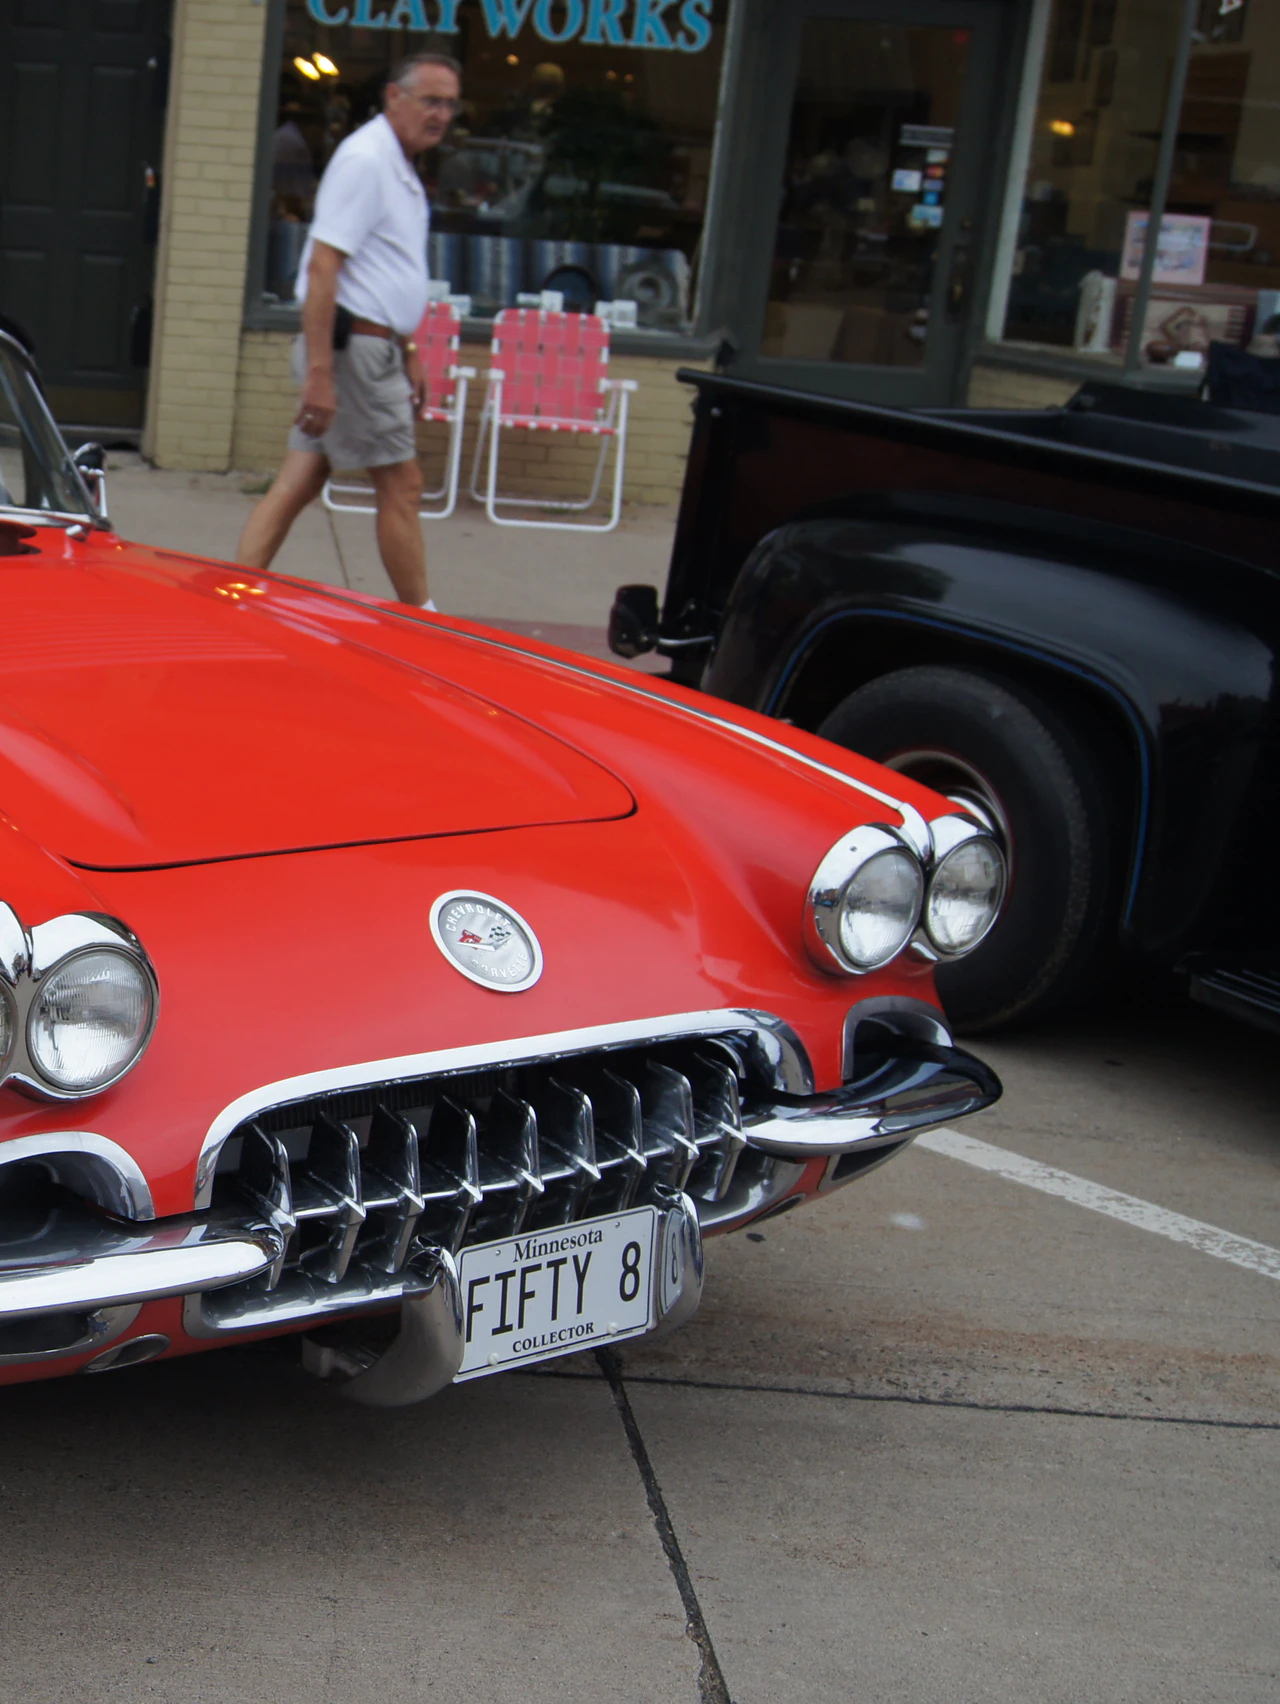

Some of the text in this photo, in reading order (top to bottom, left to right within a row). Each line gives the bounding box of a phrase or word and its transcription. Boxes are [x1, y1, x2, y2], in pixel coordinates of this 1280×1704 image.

[481, 0, 712, 52] WORKS
[445, 903, 511, 932] CHEVROLET
[470, 952, 528, 978] CORVETTE
[512, 1228, 603, 1262] Minnesota
[465, 1241, 641, 1343] FIFTY 8
[512, 1322, 595, 1353] COLLECTOR
